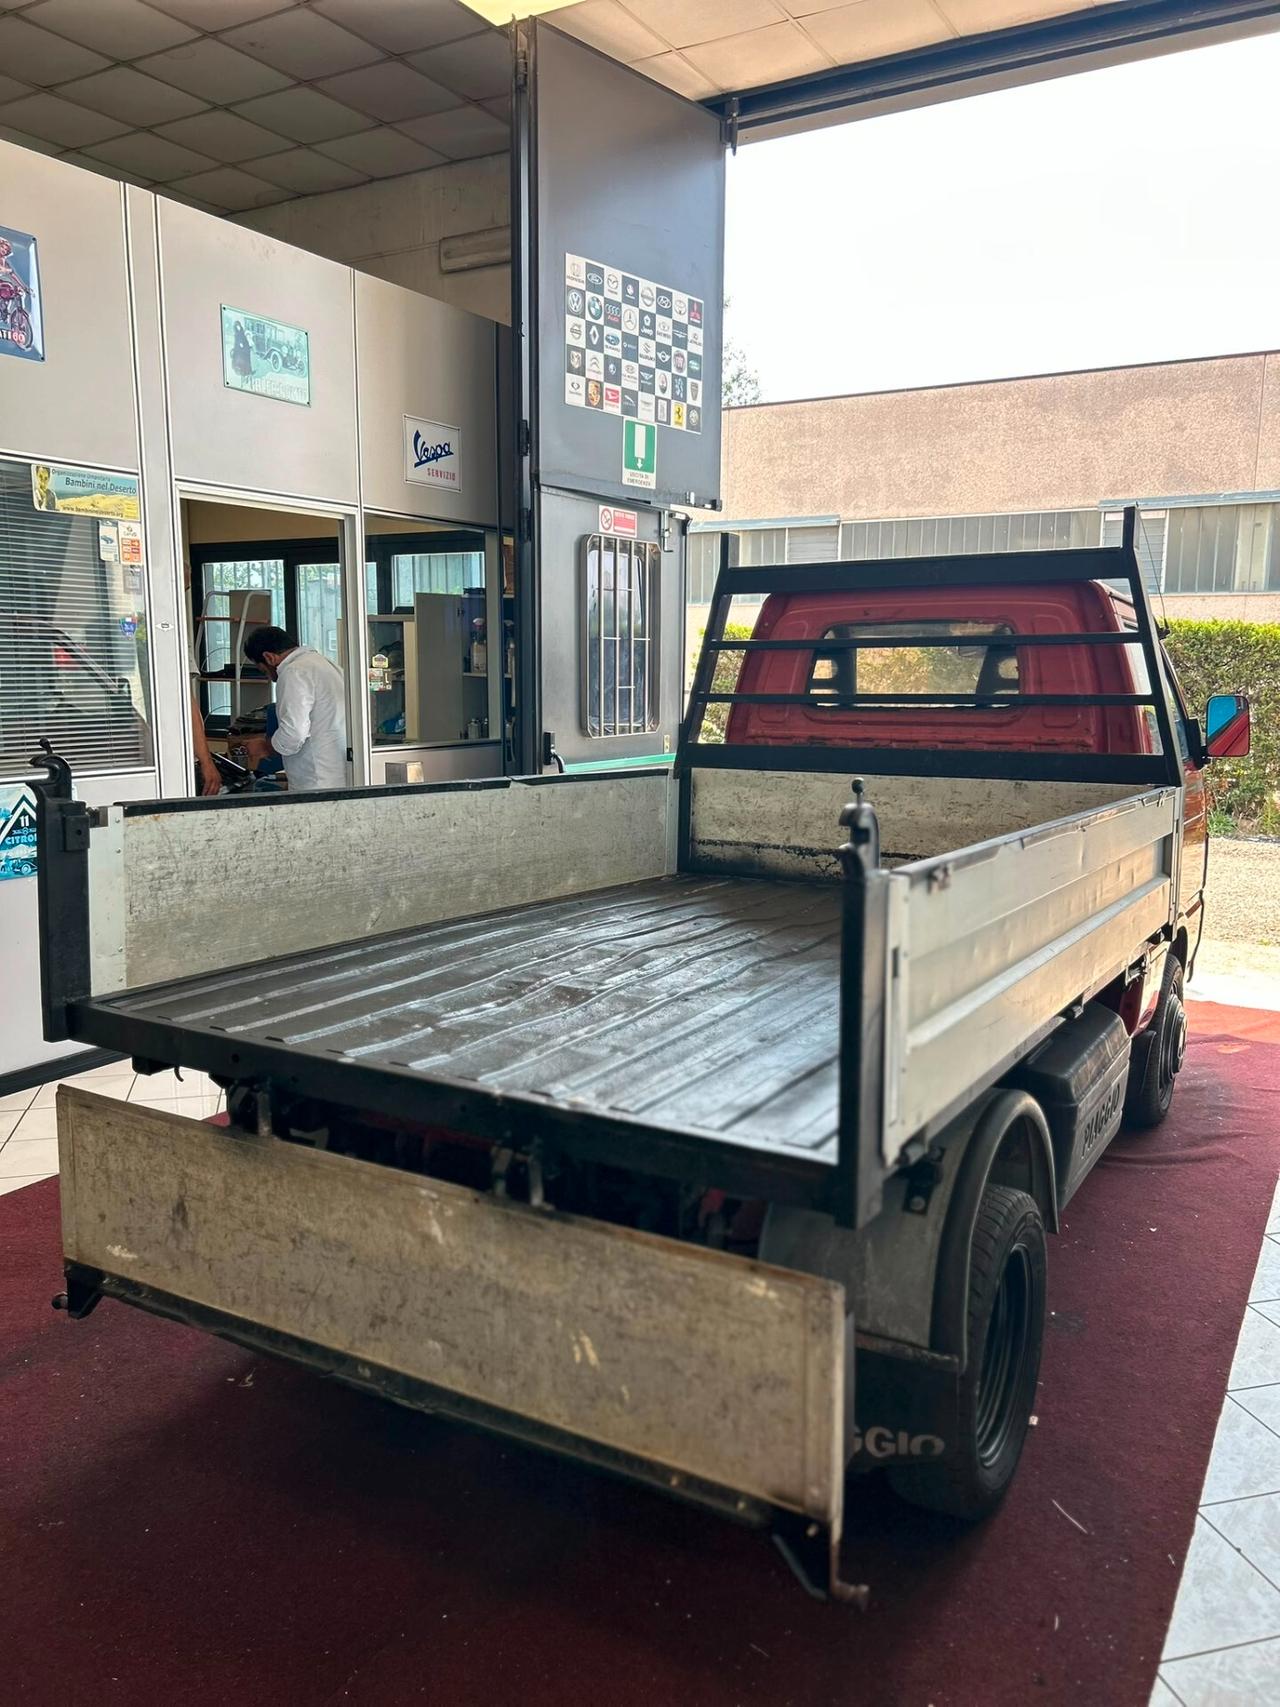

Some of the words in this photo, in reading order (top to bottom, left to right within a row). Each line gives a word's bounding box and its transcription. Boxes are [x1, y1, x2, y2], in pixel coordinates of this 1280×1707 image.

[640, 326, 654, 336] Jeep
[413, 429, 454, 468] Vespa
[427, 467, 456, 481] SERVIZIO
[65, 476, 95, 489] Bambini
[96, 482, 108, 492] nel
[109, 483, 137, 495] Deserto
[1081, 1082, 1121, 1158] PIAGGIO
